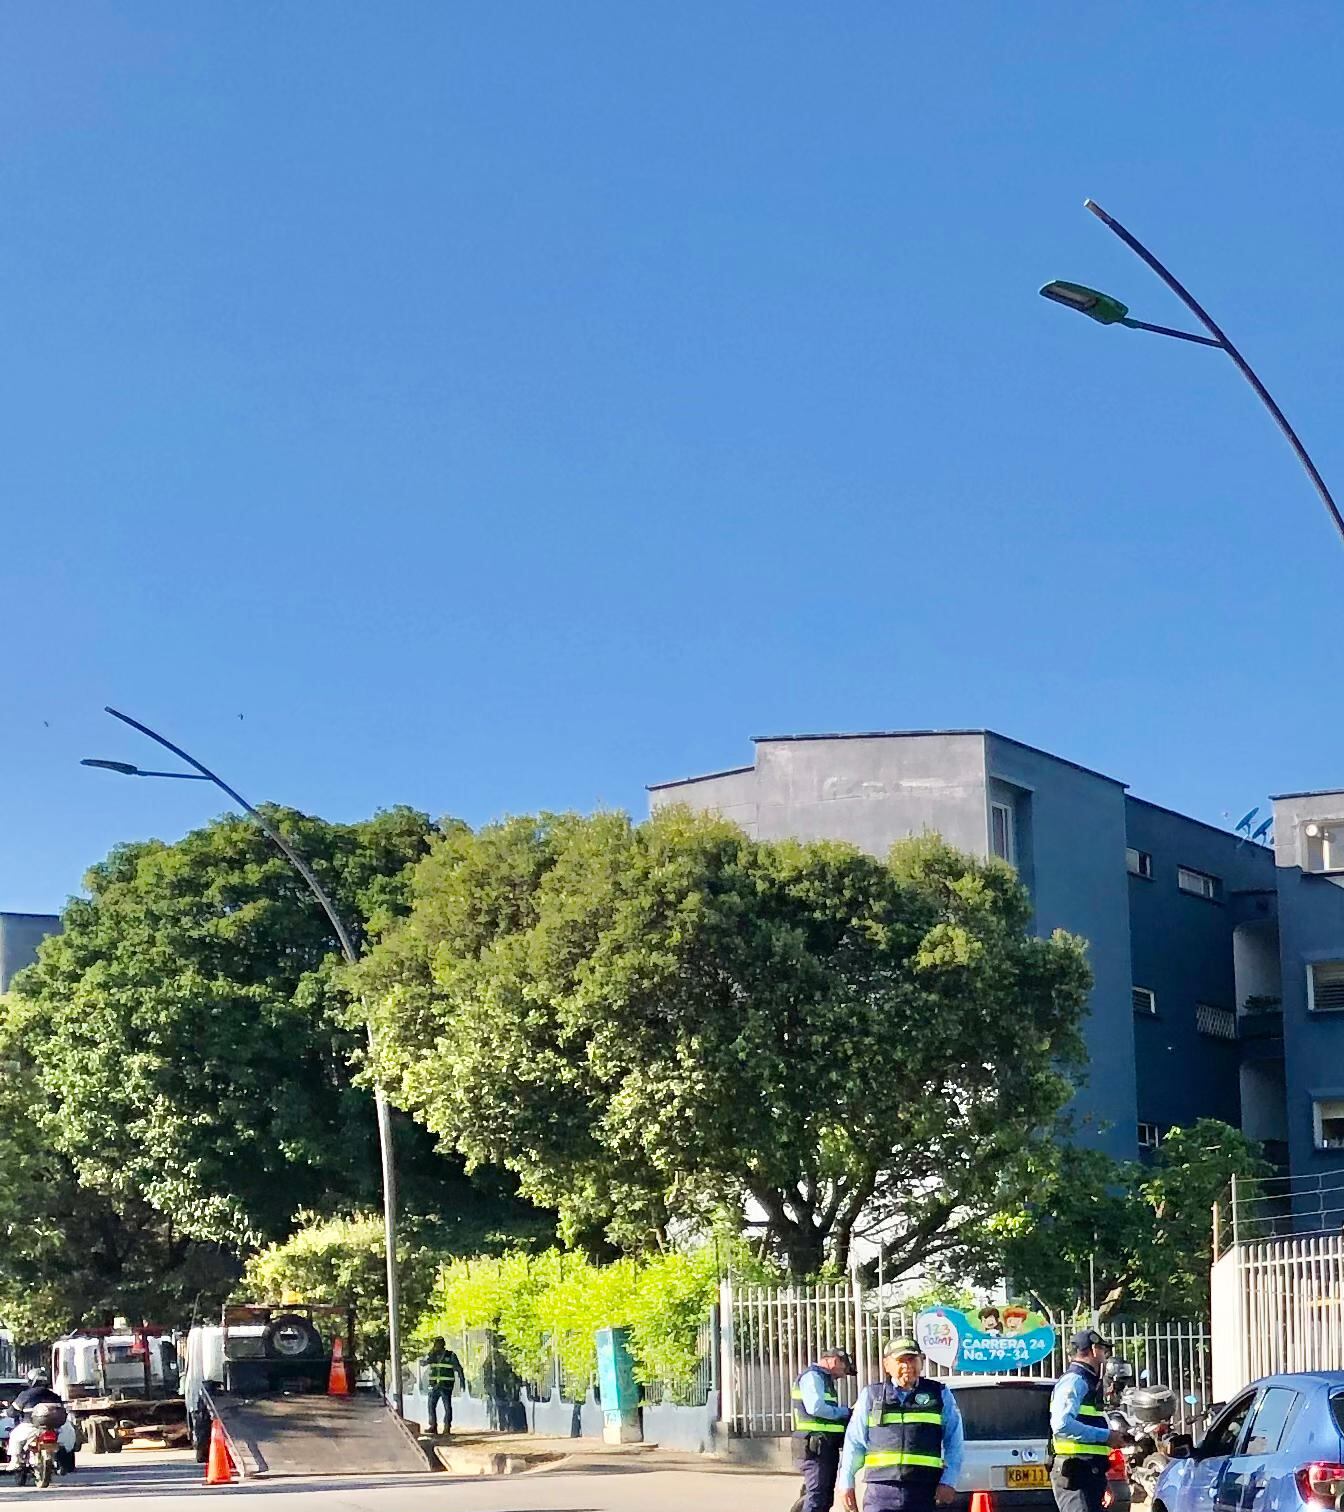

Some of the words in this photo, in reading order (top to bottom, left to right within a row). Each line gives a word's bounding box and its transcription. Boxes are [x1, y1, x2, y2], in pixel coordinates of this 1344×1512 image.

[962, 1338, 1026, 1350] CARRERA
[1029, 1338, 1046, 1350] 24
[989, 1349, 1029, 1361] 79-34
